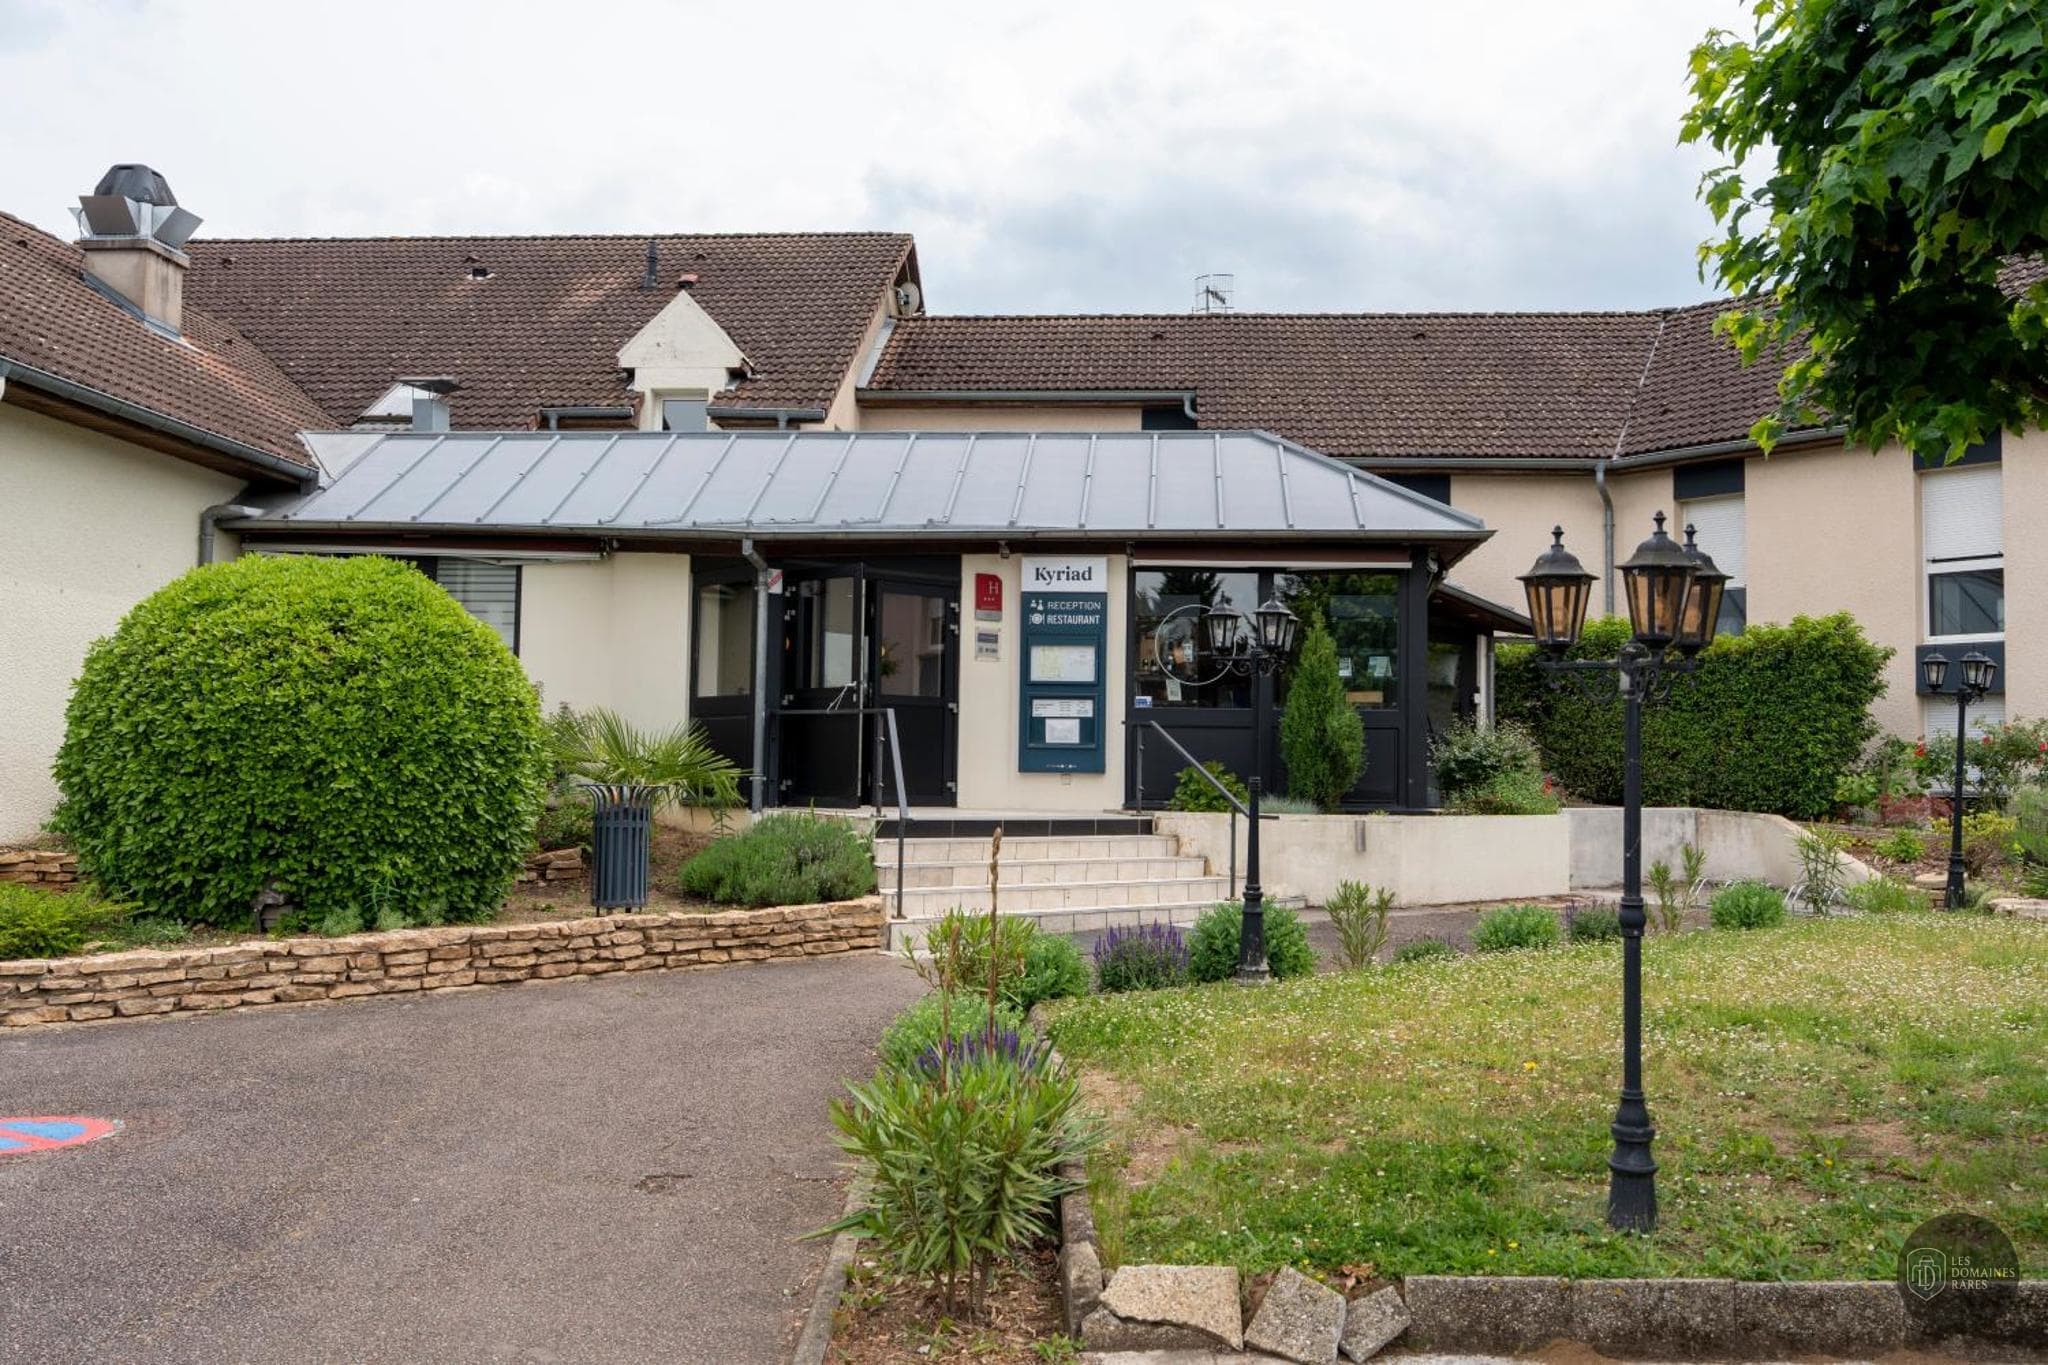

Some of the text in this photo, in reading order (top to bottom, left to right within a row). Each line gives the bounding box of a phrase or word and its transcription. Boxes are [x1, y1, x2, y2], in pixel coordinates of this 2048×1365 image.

[1035, 566, 1092, 586] Kyriad
[1047, 601, 1101, 611] RECEPTION
[1046, 614, 1101, 625] RESTAURANT
